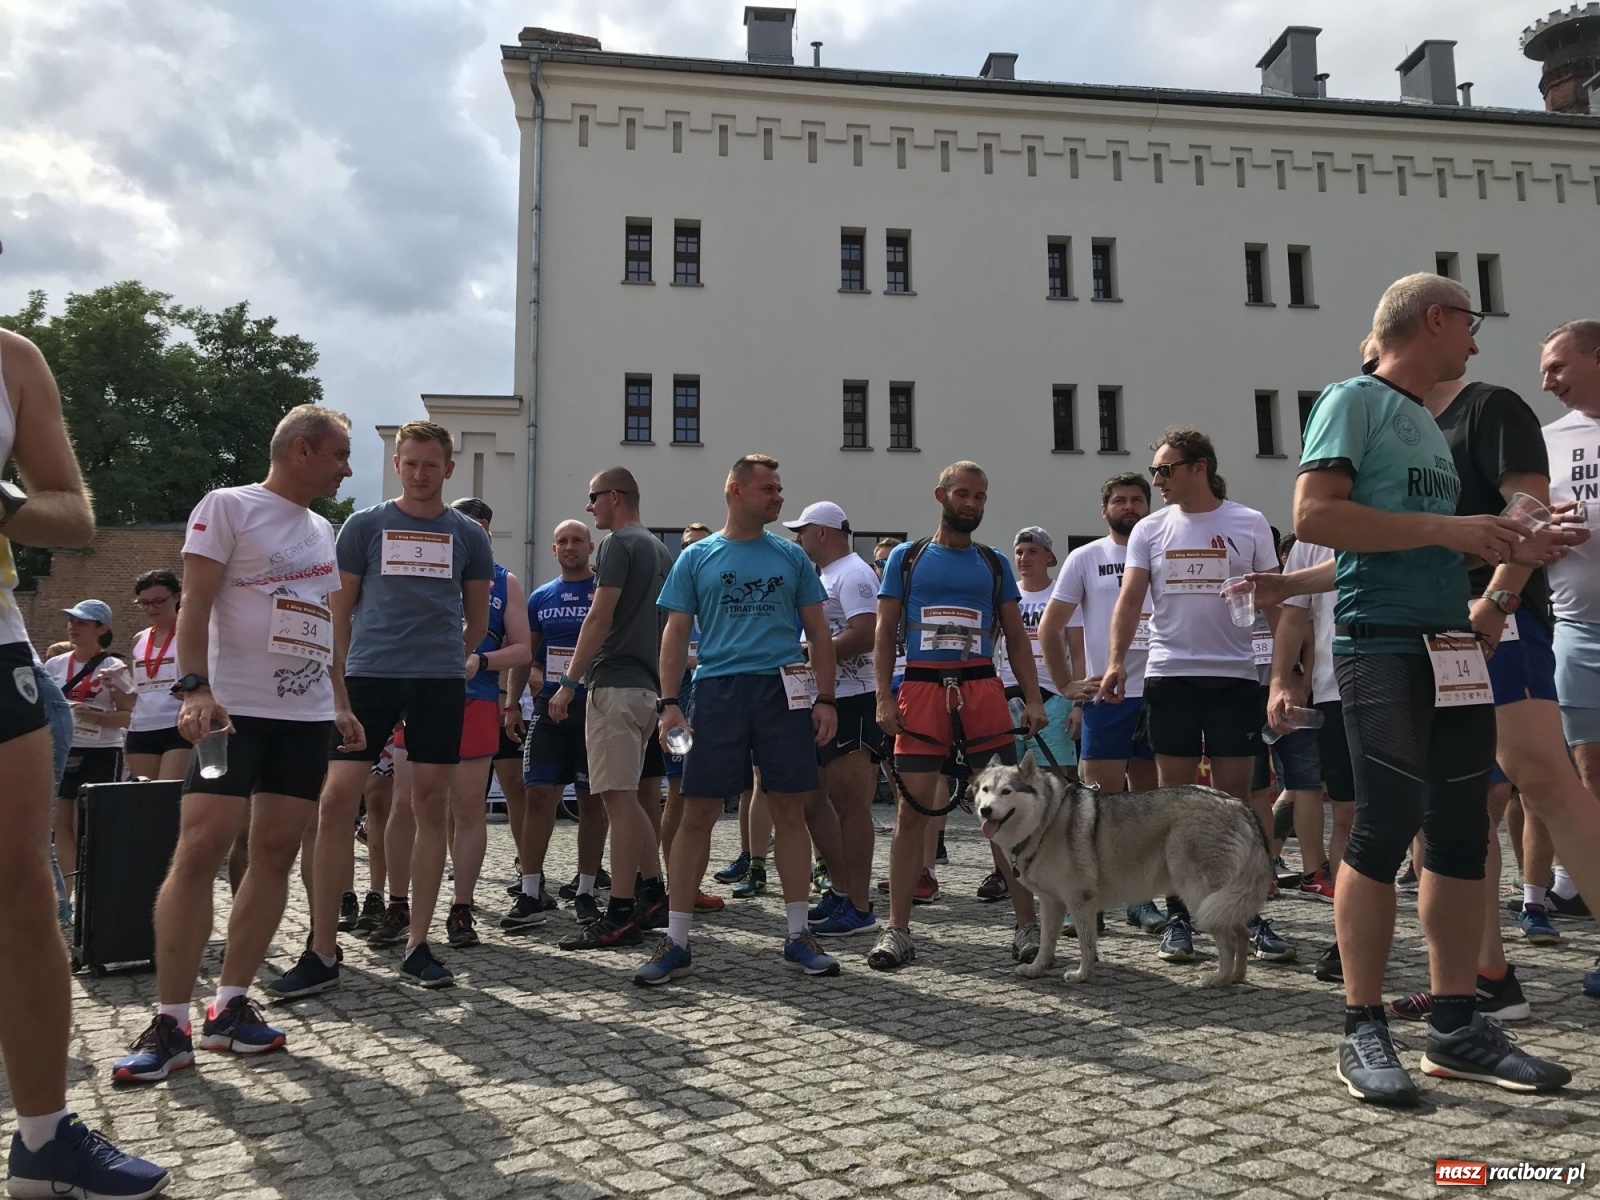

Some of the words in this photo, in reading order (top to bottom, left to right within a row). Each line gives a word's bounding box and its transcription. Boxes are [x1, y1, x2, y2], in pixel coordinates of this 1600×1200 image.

[267, 551, 285, 566] KS
[284, 542, 306, 560] GRYF
[414, 546, 423, 558] 3
[1187, 564, 1204, 575] 47
[729, 604, 775, 613] TRIATHLON
[301, 621, 317, 638] 34
[1255, 643, 1268, 652] 38
[1455, 659, 1470, 677] 14
[523, 714, 541, 773] RUNNERS
